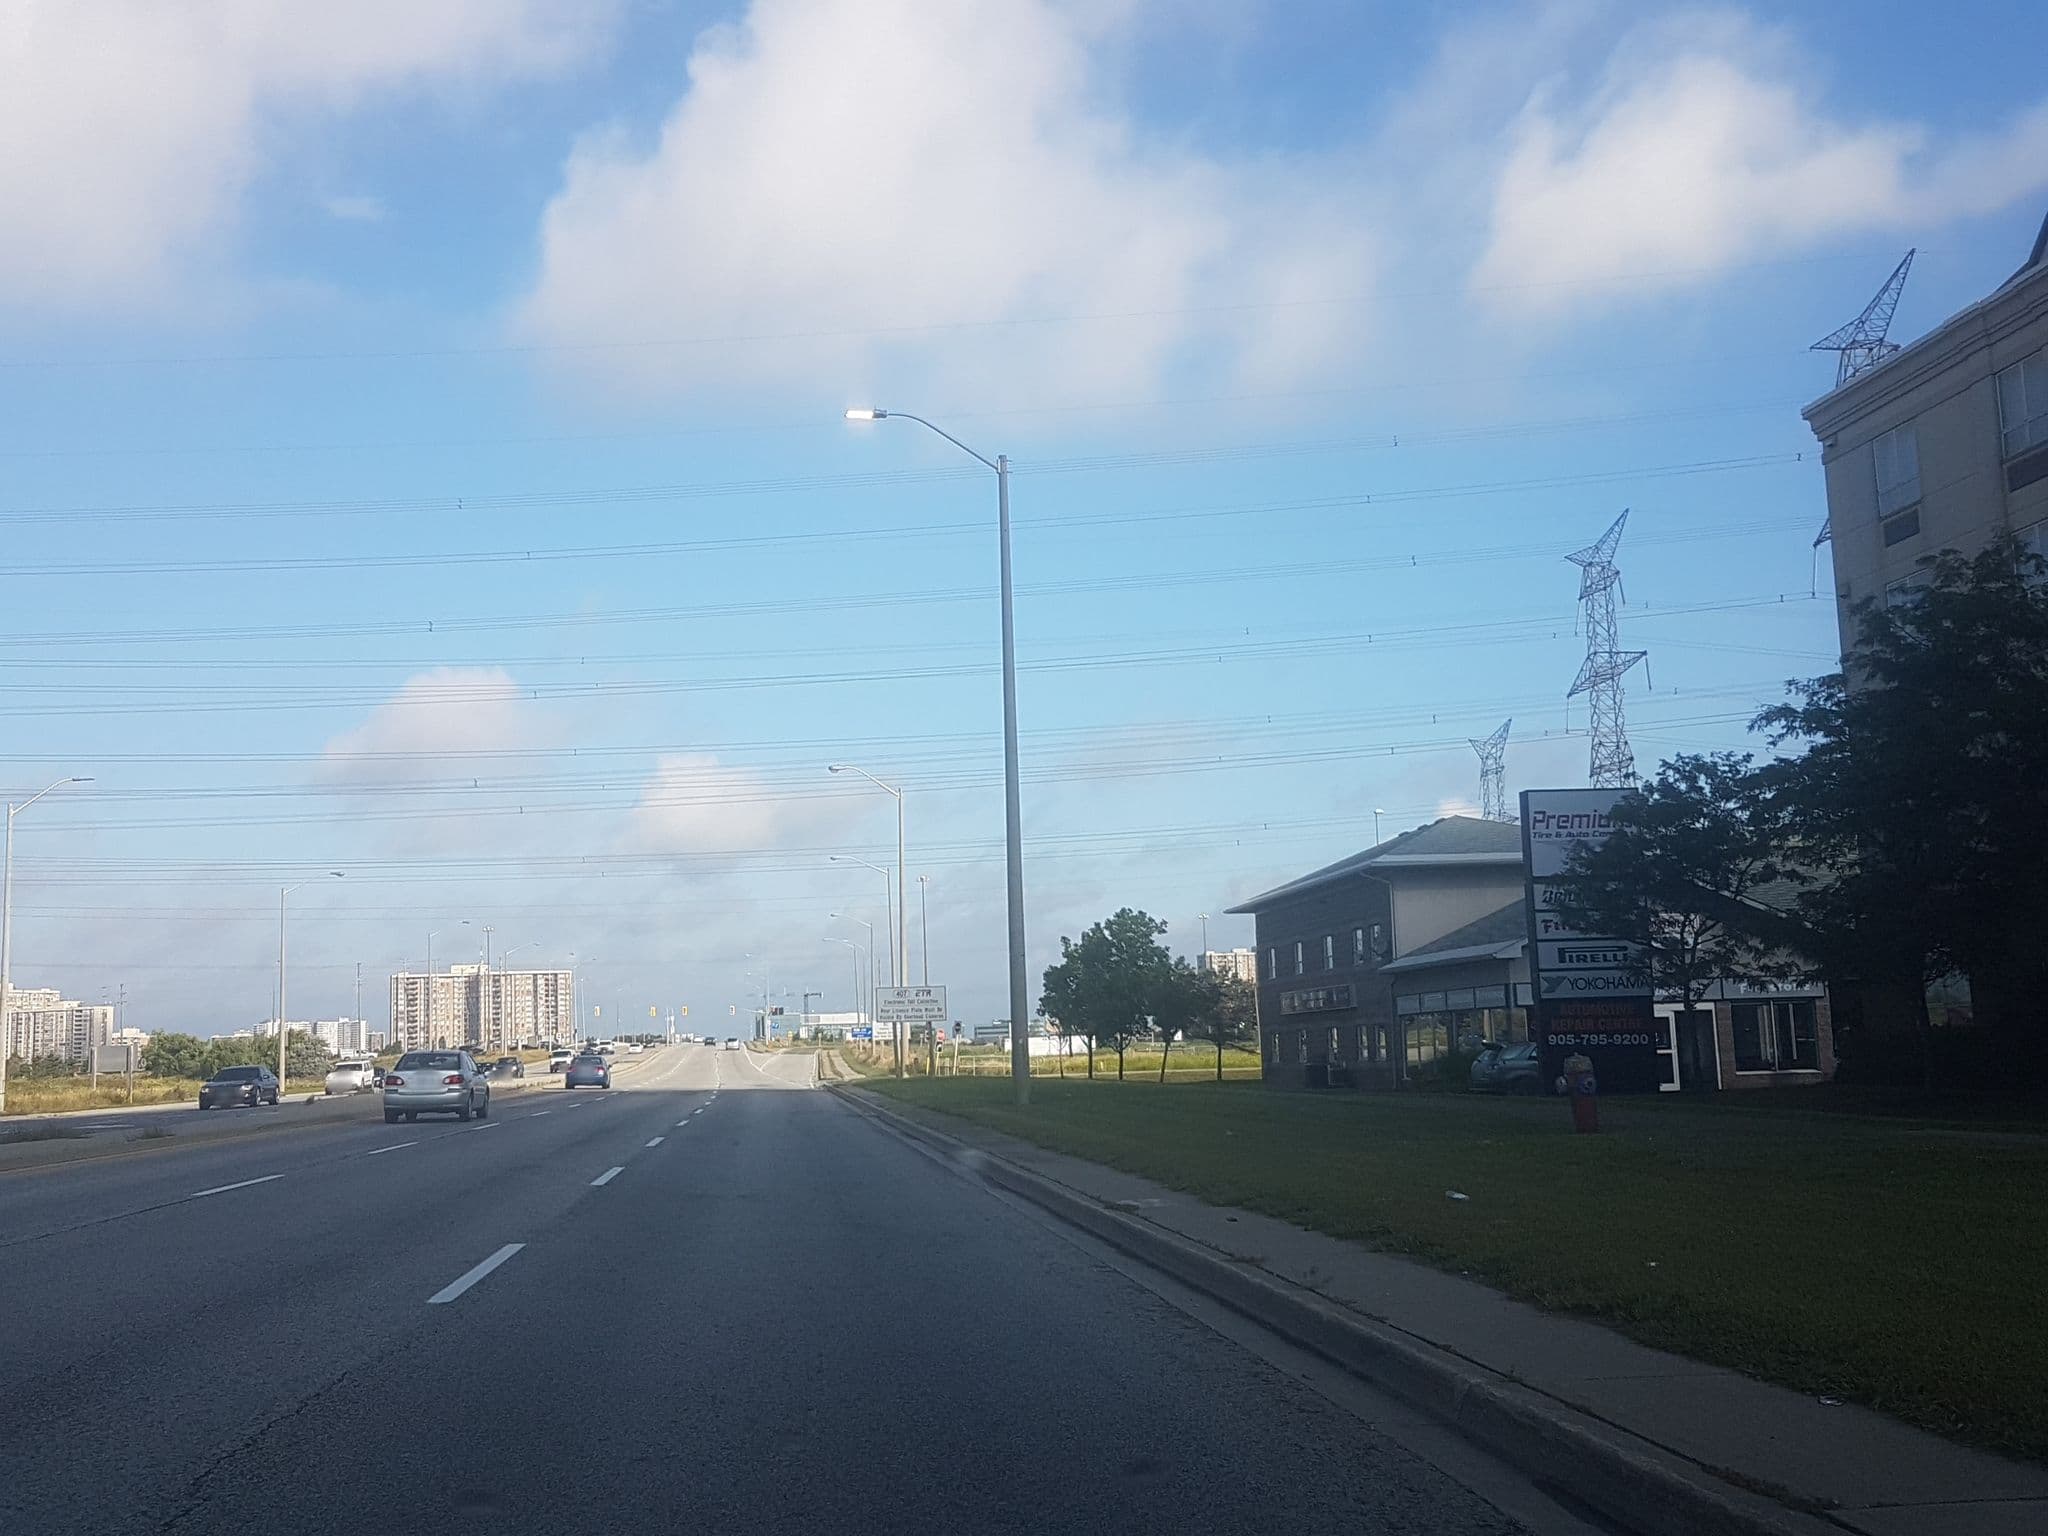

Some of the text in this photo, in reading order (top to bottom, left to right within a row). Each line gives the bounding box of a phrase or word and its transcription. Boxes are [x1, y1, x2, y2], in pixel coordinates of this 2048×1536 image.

[1532, 831, 1552, 839] Tire
[1555, 831, 1564, 839] &
[1566, 830, 1590, 838] Auto
[1557, 946, 1629, 963] PIRELLI
[1567, 976, 1649, 991] YOKOHAMA
[1547, 1034, 1649, 1046] 905-795-9200
